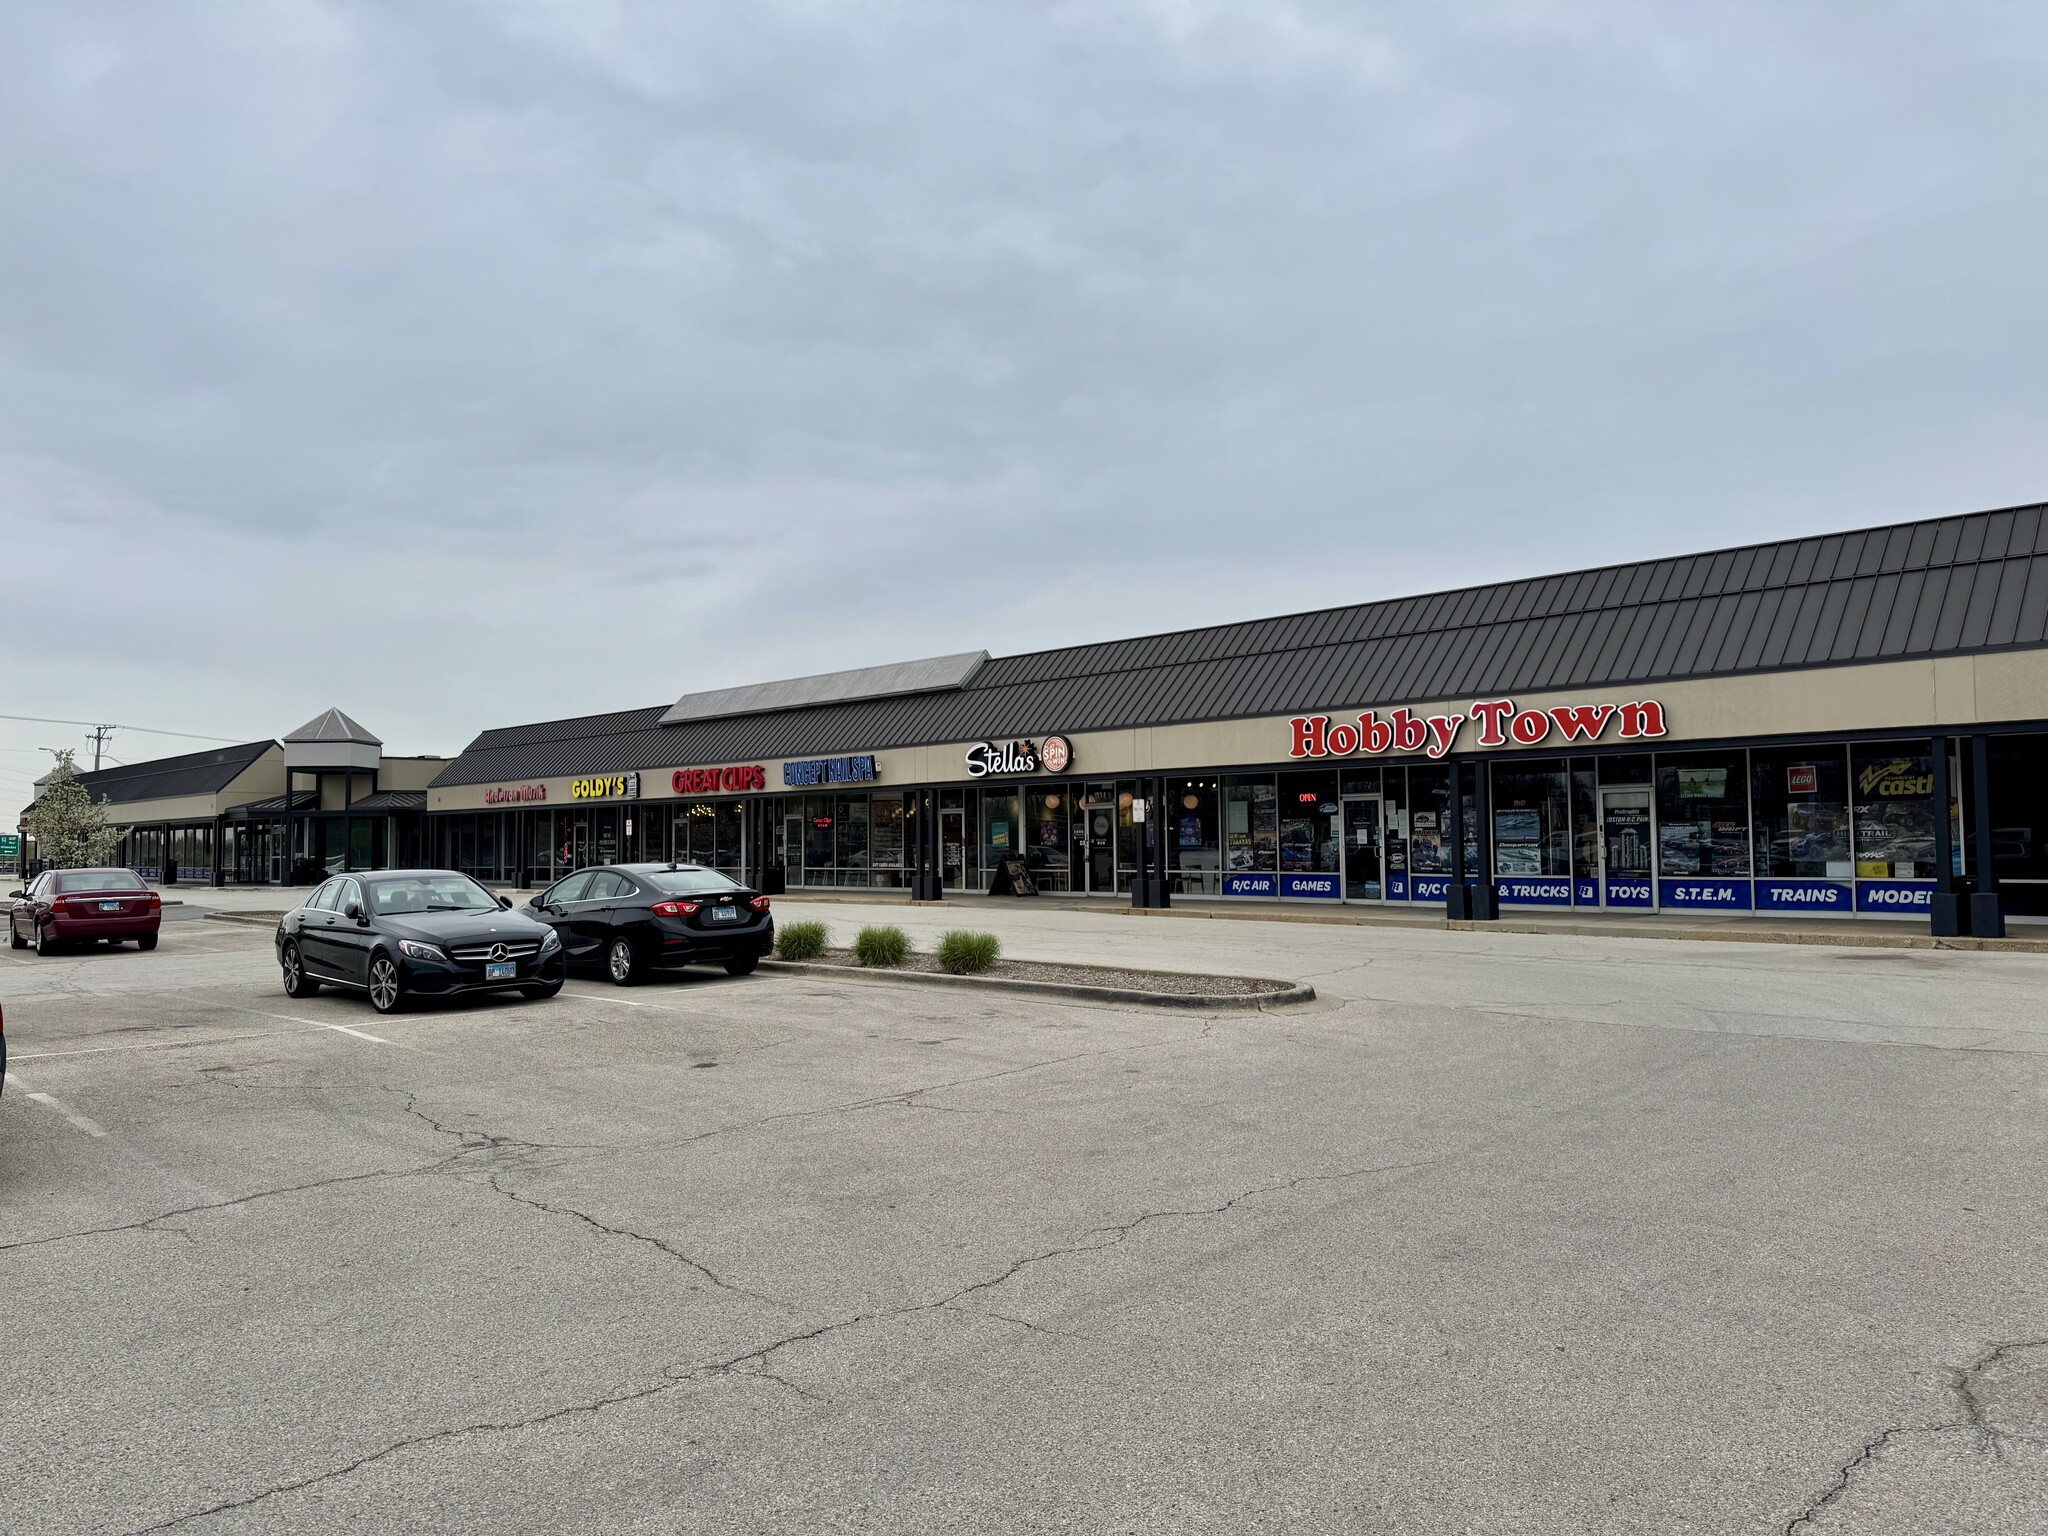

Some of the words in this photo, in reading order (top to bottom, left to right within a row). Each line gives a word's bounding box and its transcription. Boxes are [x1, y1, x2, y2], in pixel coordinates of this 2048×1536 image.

[1289, 708, 1464, 758] Hobby
[1470, 699, 1667, 746] Town
[1043, 746, 1066, 760] SPIN
[783, 760, 829, 787] CONCEPT
[829, 757, 853, 783] NAIL
[852, 755, 876, 782] SPA
[672, 764, 722, 793] GREAT
[722, 764, 766, 791] CLIPS
[1791, 775, 1812, 785] LEGO
[1879, 774, 1934, 796] castl
[571, 776, 625, 798] GOLDY'S
[1299, 793, 1317, 802] OPEN
[1232, 880, 1250, 893] R/C
[1251, 880, 1270, 891] AIR
[1292, 880, 1332, 892] GAMES
[1418, 883, 1441, 897] R/C
[1498, 884, 1509, 897] &
[1511, 884, 1569, 898] TRUCKS
[1609, 886, 1650, 899] TOYS
[1674, 887, 1736, 901] S.T.E.M.
[1770, 888, 1838, 902] TRAINS
